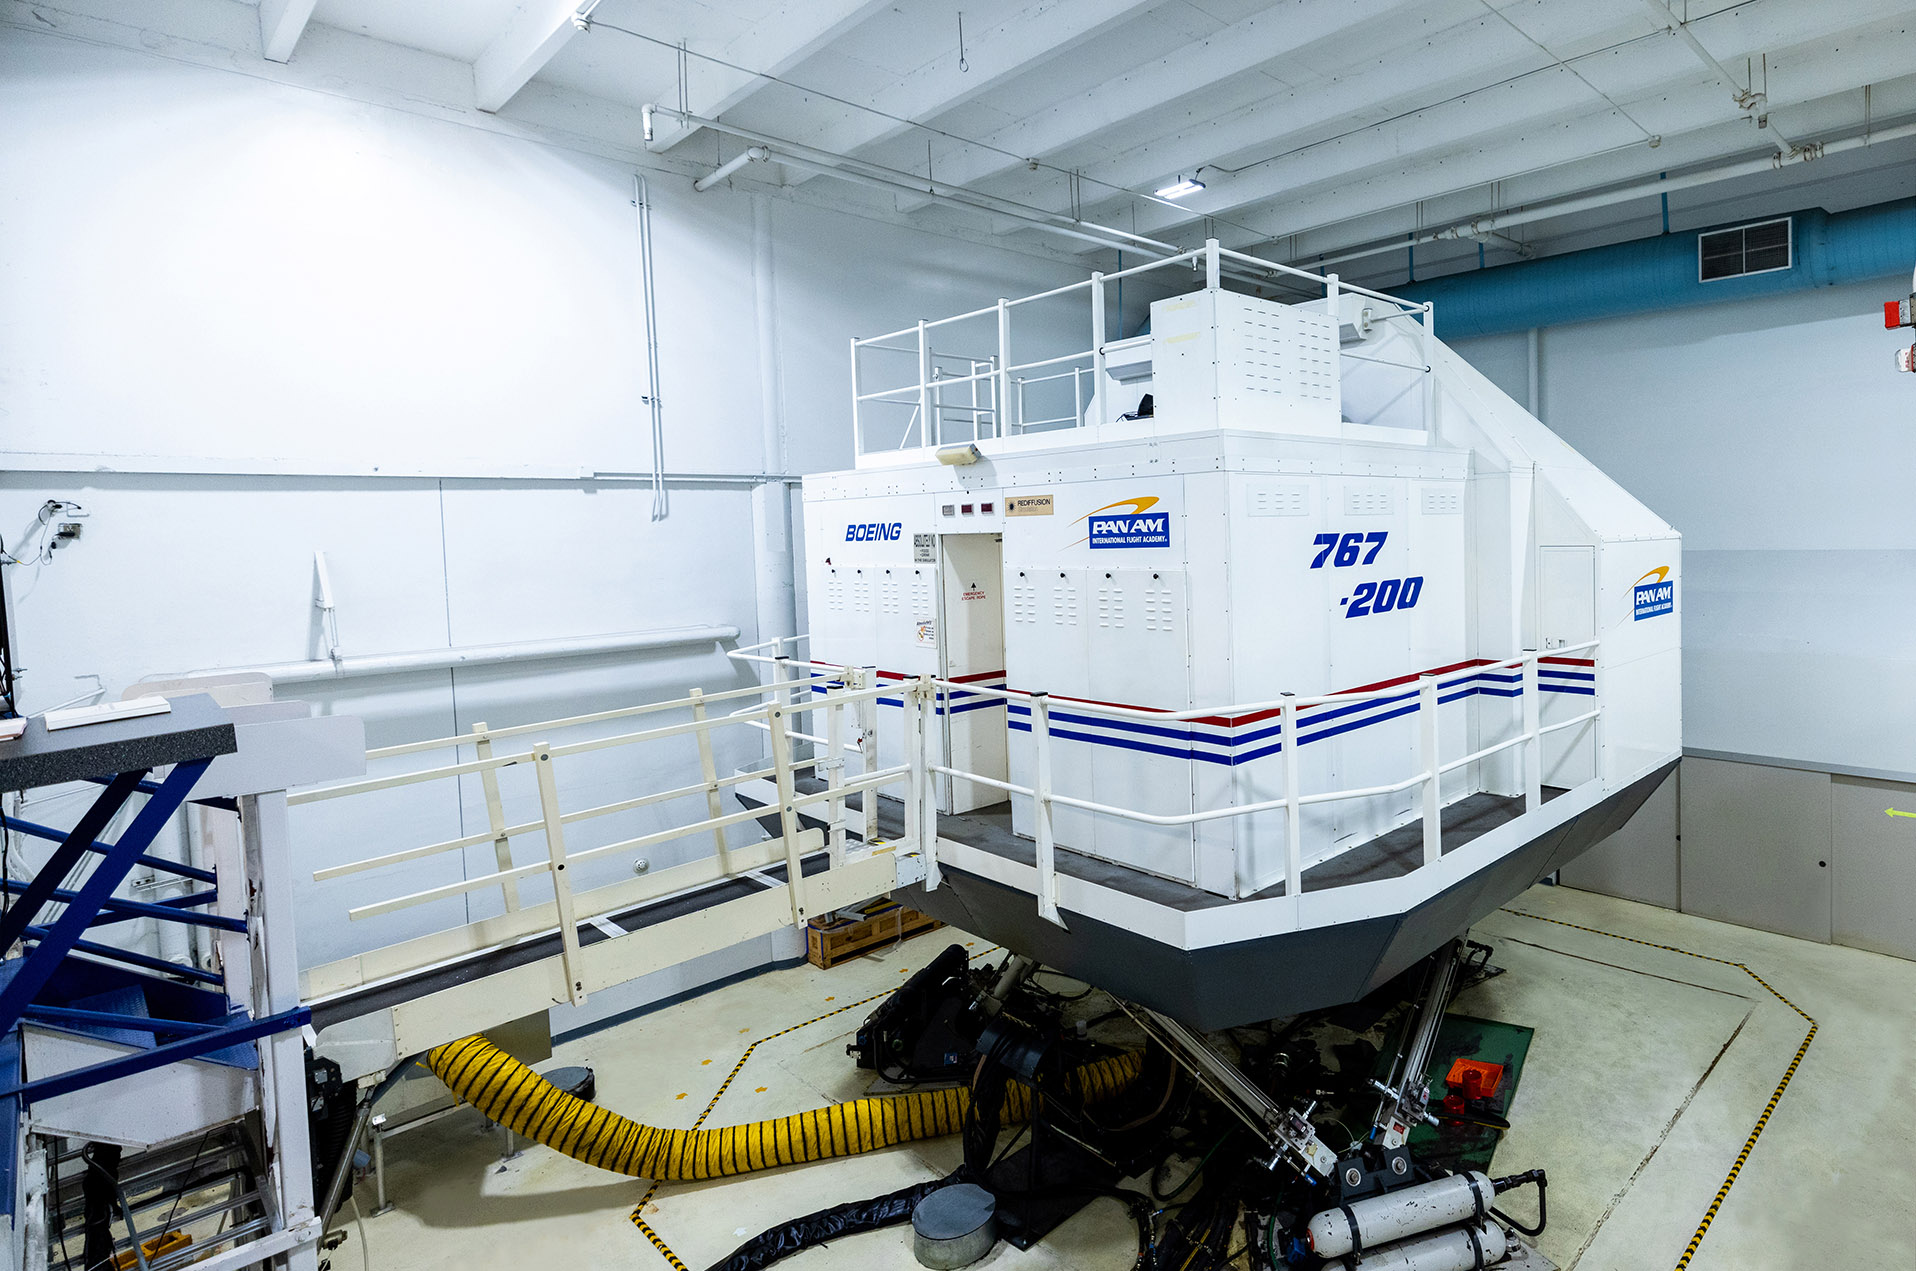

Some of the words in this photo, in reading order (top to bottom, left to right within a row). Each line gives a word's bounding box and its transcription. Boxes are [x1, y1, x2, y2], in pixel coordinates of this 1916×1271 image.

[1017, 498, 1051, 507] REDIFFUSION
[845, 522, 902, 541] BOEING
[1092, 520, 1131, 534] PAN
[1130, 518, 1165, 533] AM
[1309, 531, 1388, 569] 767
[1340, 576, 1424, 618] -200
[1636, 589, 1656, 605] PAN
[1656, 586, 1671, 601] AM
